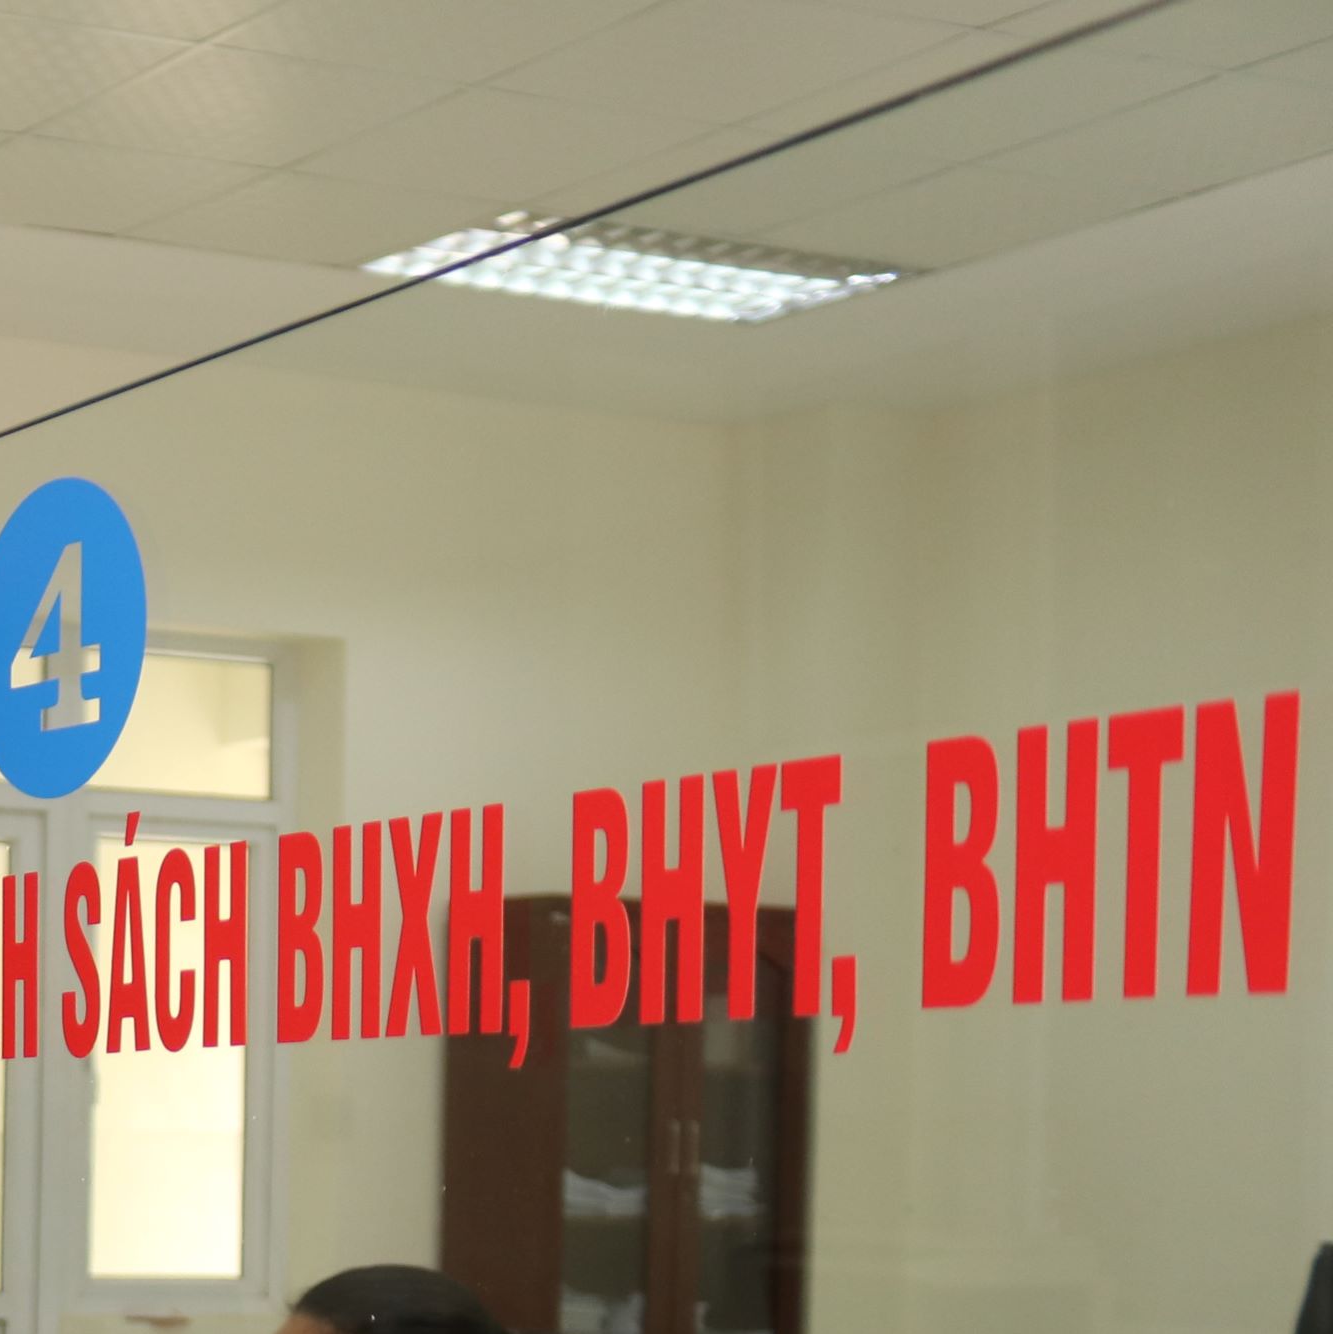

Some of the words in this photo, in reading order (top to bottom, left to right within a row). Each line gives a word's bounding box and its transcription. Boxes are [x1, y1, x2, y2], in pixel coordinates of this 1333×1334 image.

[10, 540, 101, 732] 4
[62, 811, 249, 1060] SÁCH
[276, 802, 531, 1069] BHXH,
[569, 753, 858, 1057] BHYT,
[921, 690, 1300, 1010] BHTN
